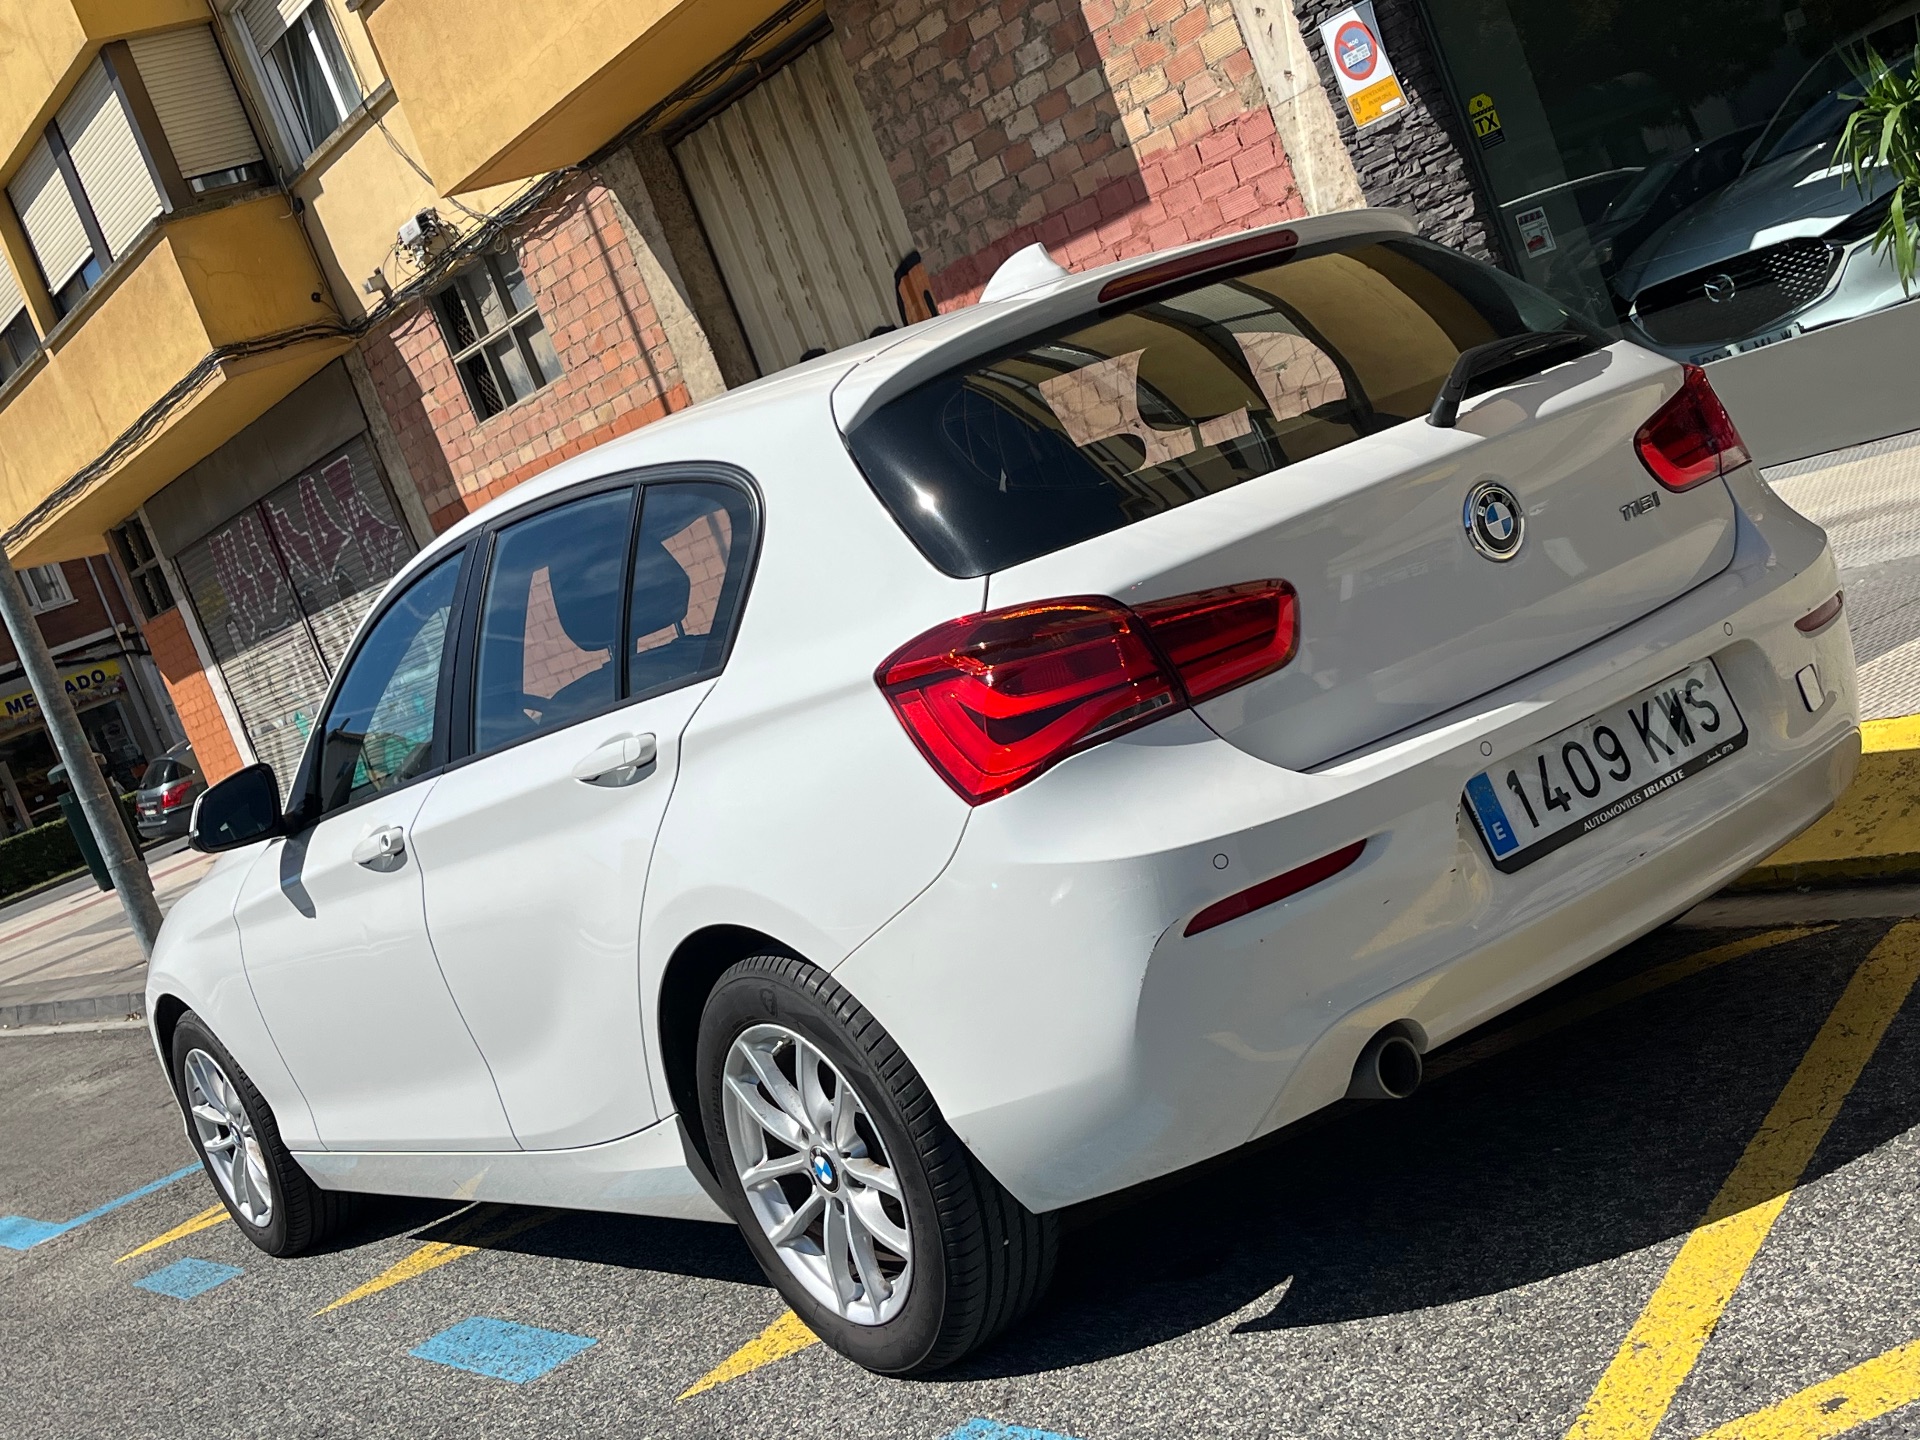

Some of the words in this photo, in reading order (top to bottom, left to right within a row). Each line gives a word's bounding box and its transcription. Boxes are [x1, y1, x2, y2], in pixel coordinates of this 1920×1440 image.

[1474, 112, 1499, 134] TX
[4, 669, 106, 715] MEADO
[1506, 725, 1632, 829] 1409
[1627, 678, 1720, 764] KWS
[1643, 769, 1686, 798] IRIARTE
[1491, 821, 1507, 840] E
